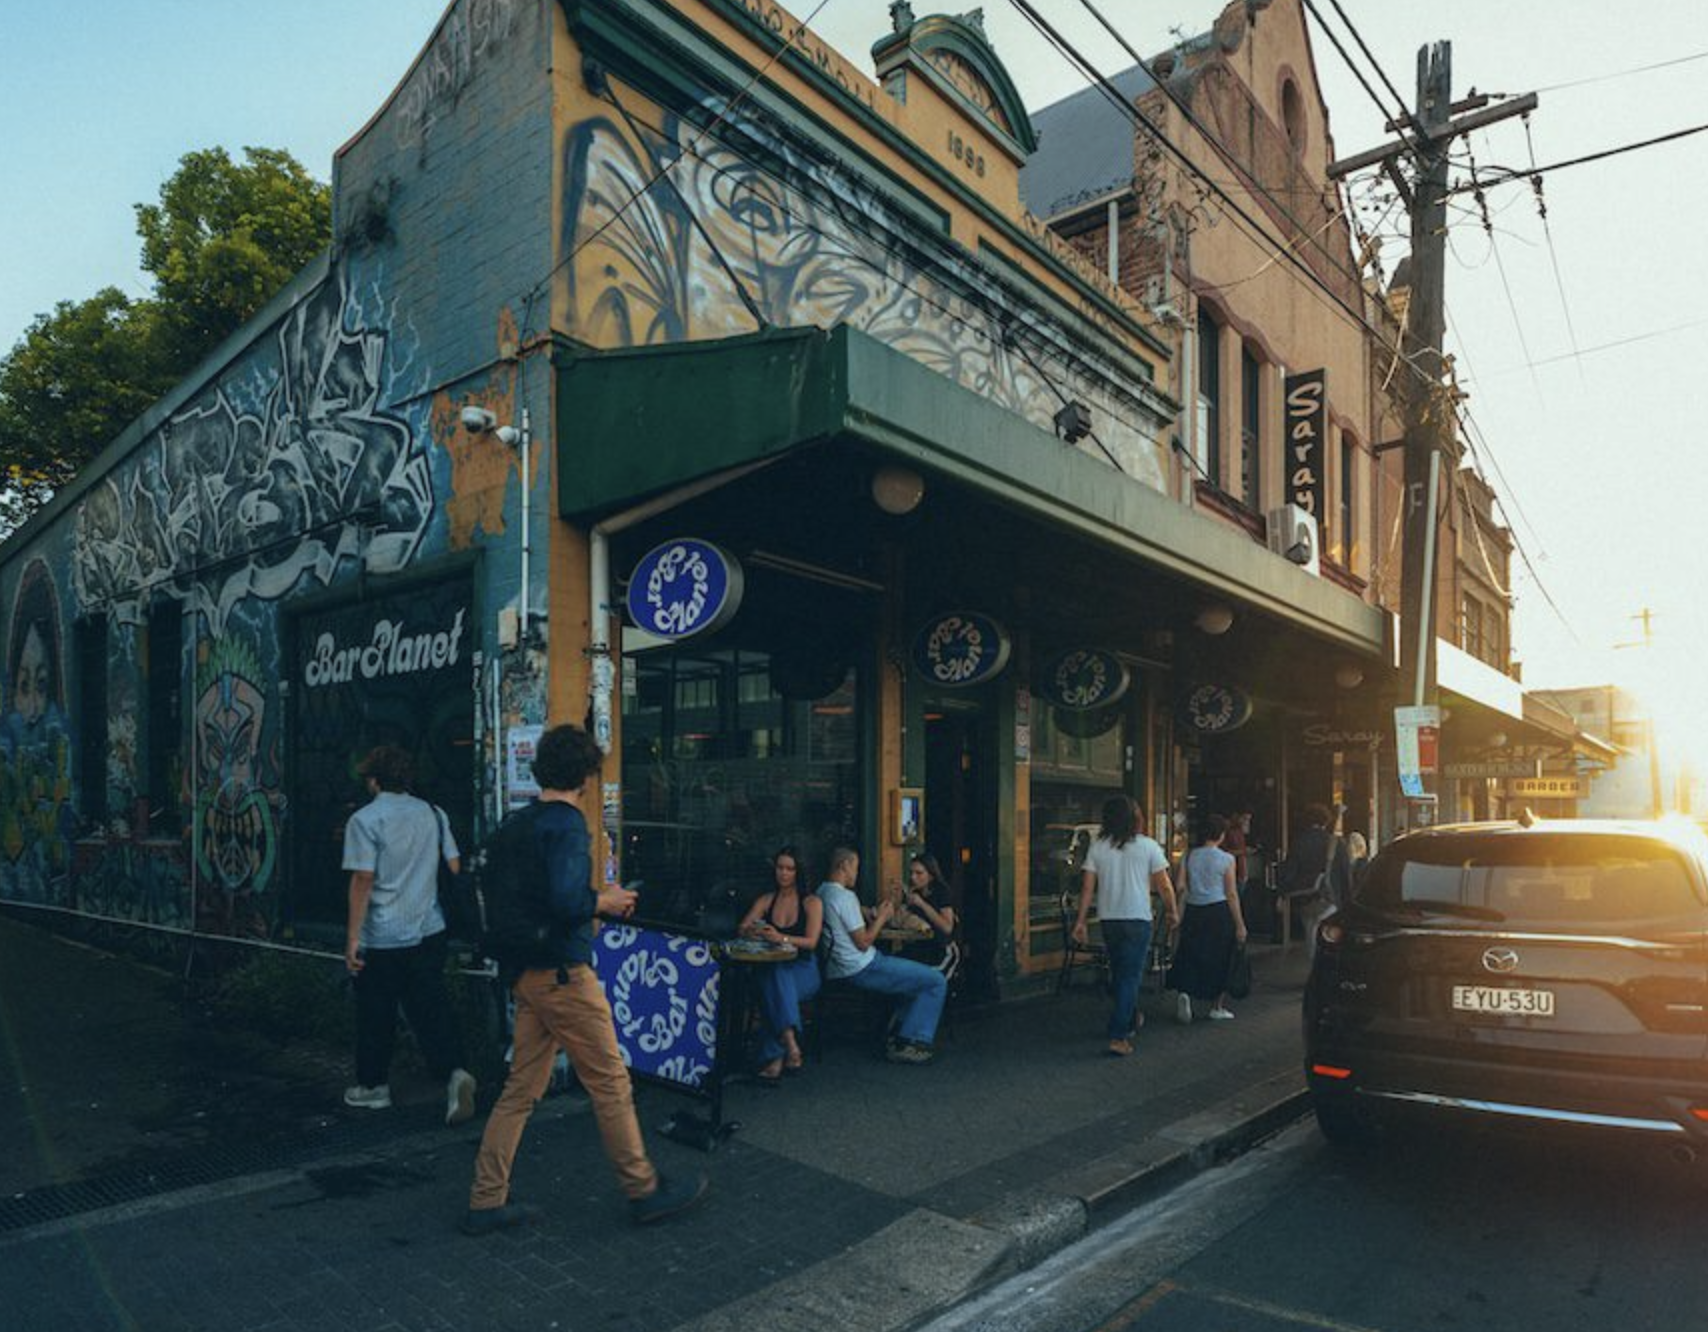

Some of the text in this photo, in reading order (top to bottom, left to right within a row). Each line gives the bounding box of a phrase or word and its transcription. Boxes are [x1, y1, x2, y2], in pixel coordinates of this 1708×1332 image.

[1287, 381, 1323, 514] Saray
[648, 546, 709, 633] Bar Planet
[305, 607, 467, 687] Bar Planet
[928, 618, 982, 682] Bar Planet
[613, 950, 680, 1039] Planet
[638, 987, 689, 1053] Bar
